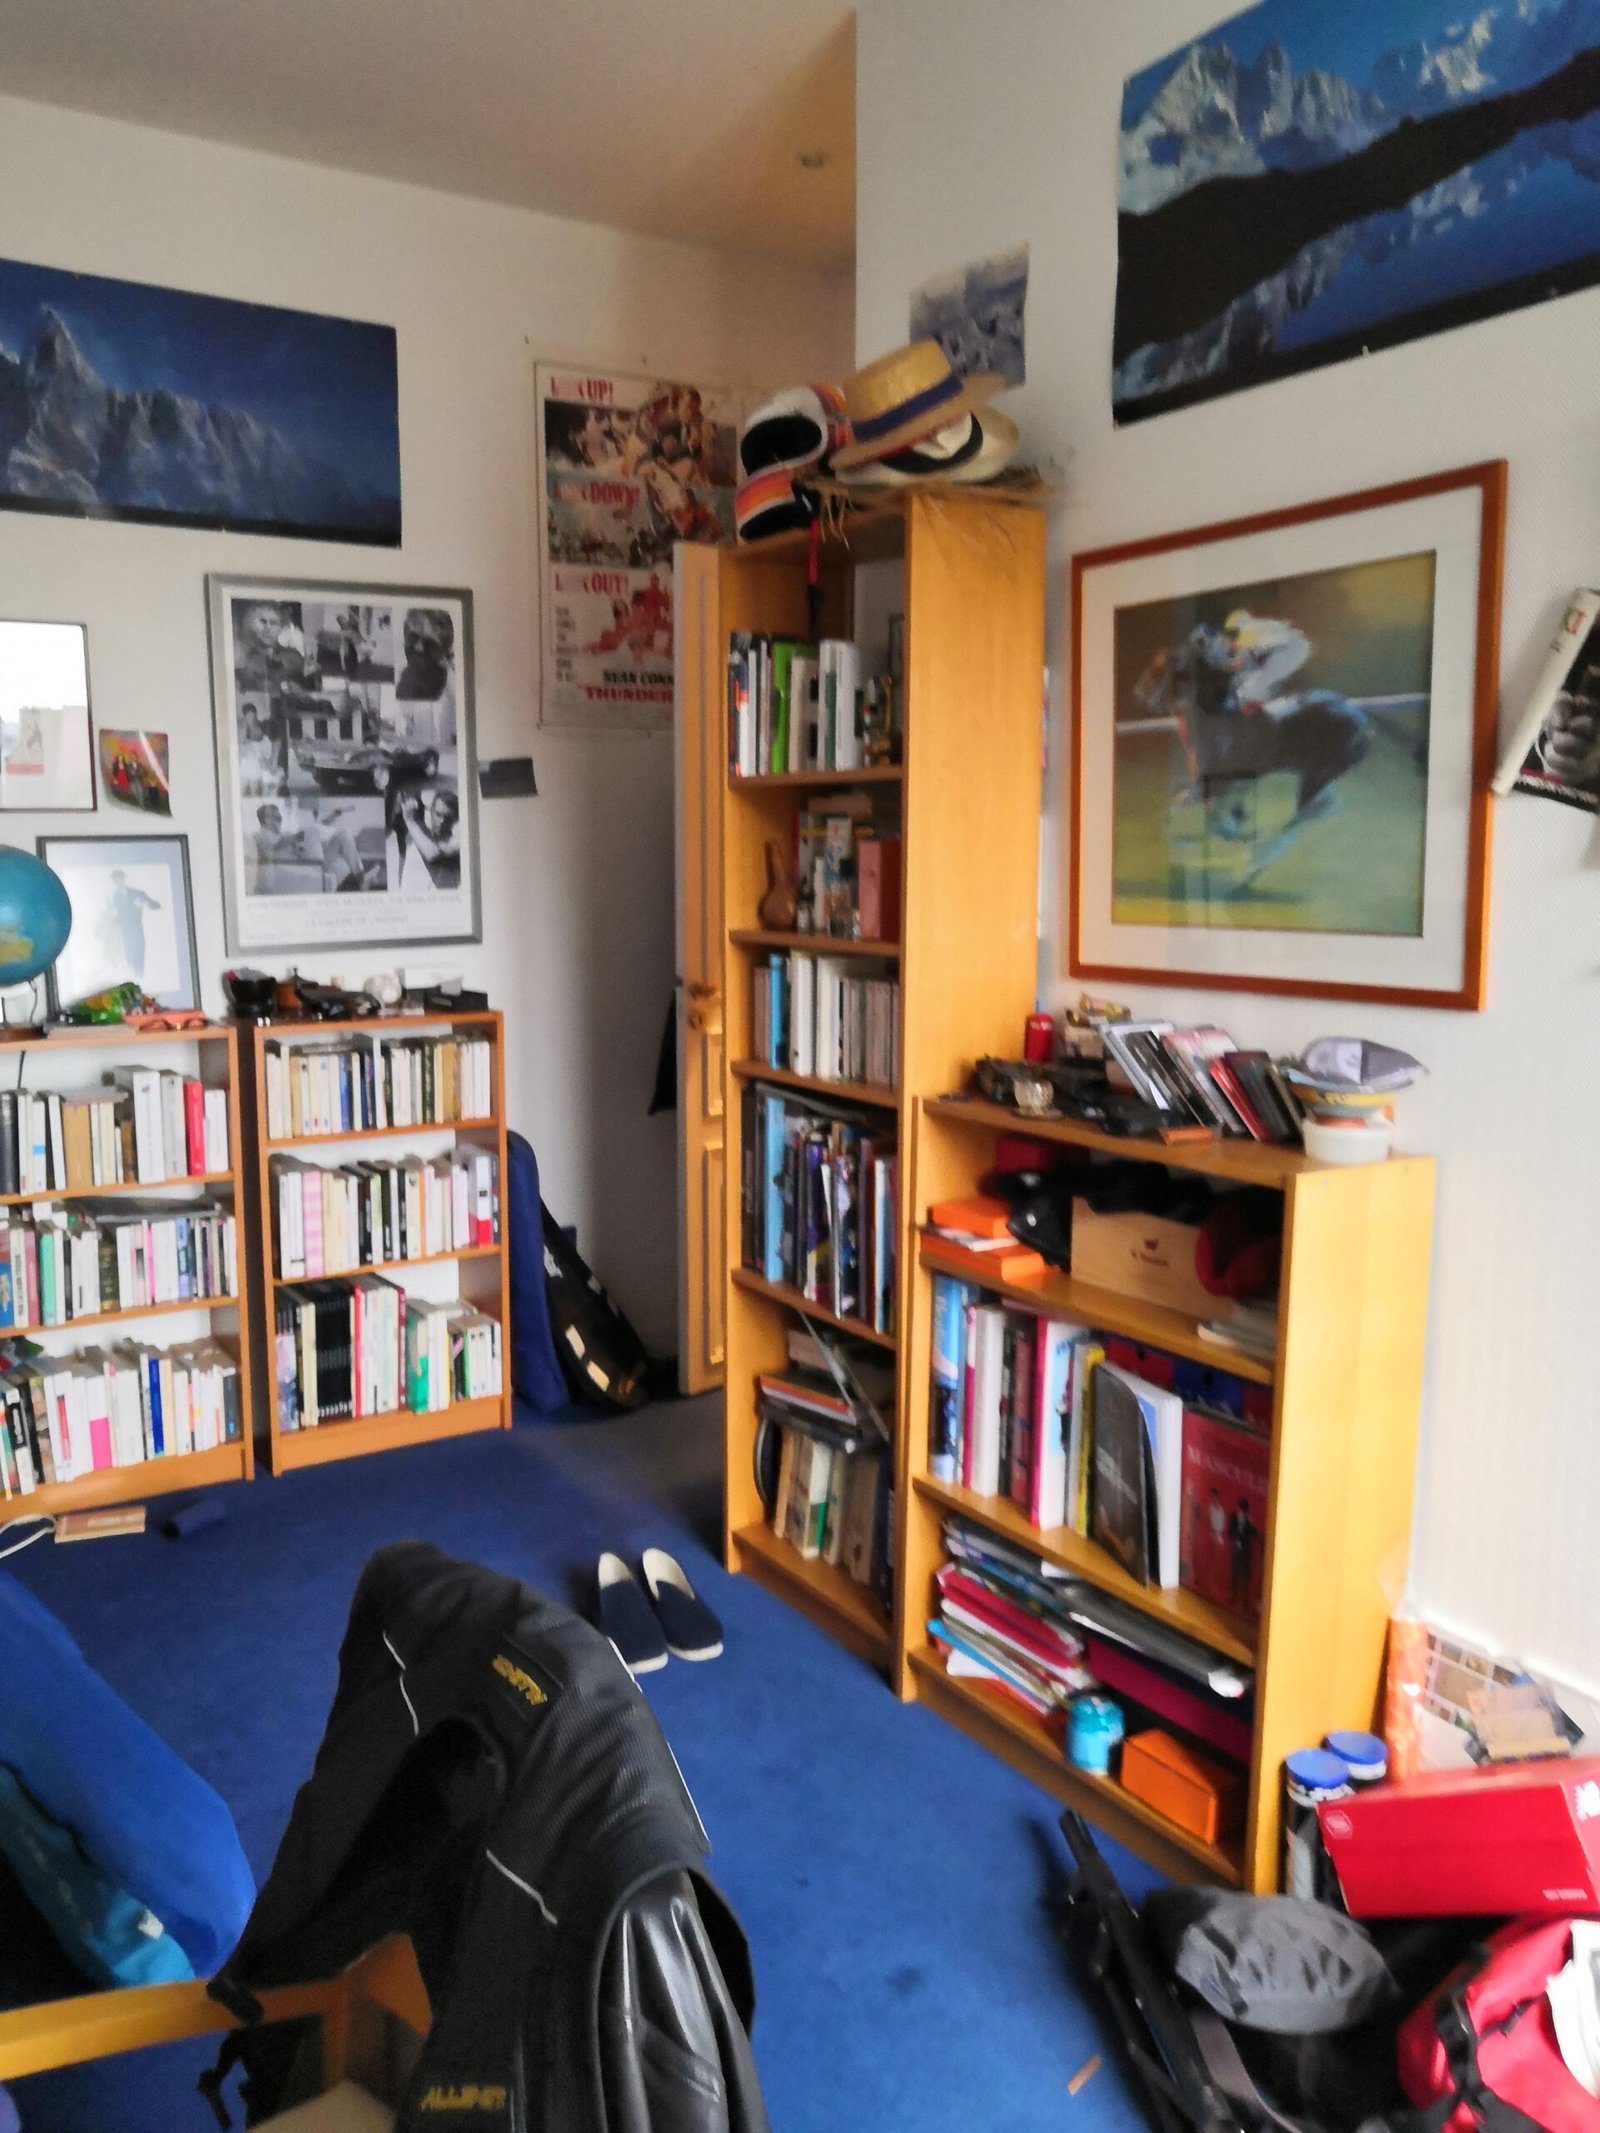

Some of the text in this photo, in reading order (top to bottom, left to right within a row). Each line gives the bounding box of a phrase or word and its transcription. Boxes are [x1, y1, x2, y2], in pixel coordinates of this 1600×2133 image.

[551, 376, 614, 405] LK UP!
[555, 571, 589, 593] LK
